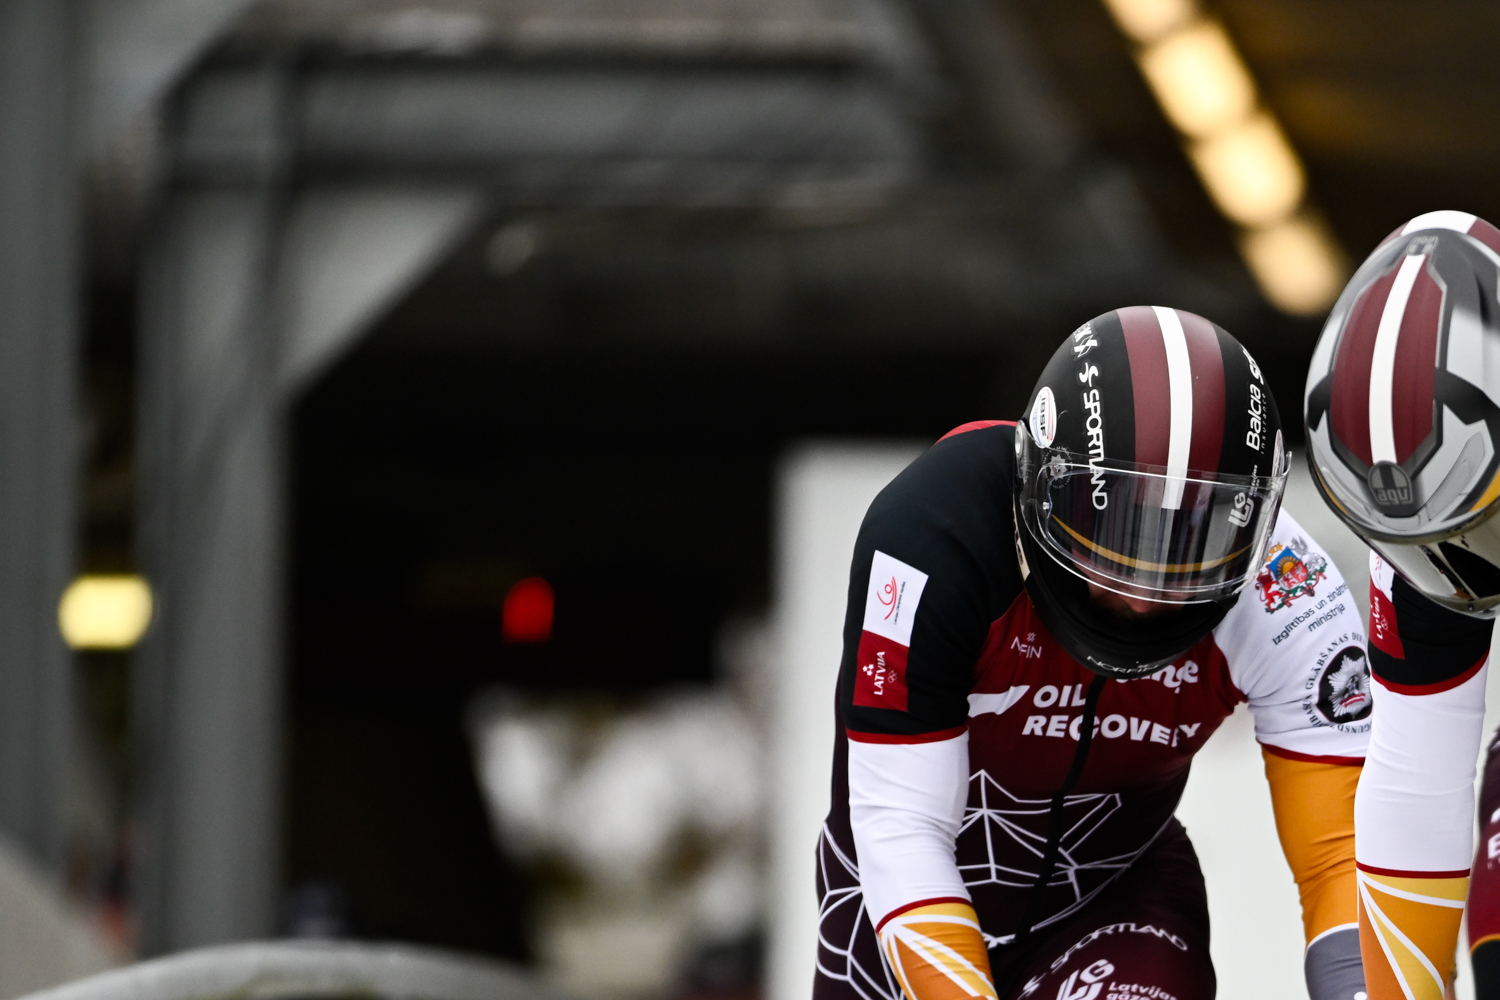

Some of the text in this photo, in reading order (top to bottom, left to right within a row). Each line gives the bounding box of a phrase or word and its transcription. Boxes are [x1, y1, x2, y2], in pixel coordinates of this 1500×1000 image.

[1246, 383, 1261, 451] Balcia
[1083, 389, 1108, 510] SPORTLAND
[1308, 603, 1346, 632] ministrija
[1315, 598, 1328, 611] un
[1033, 683, 1087, 709] OIL
[1050, 922, 1188, 974] SPORTLAND
